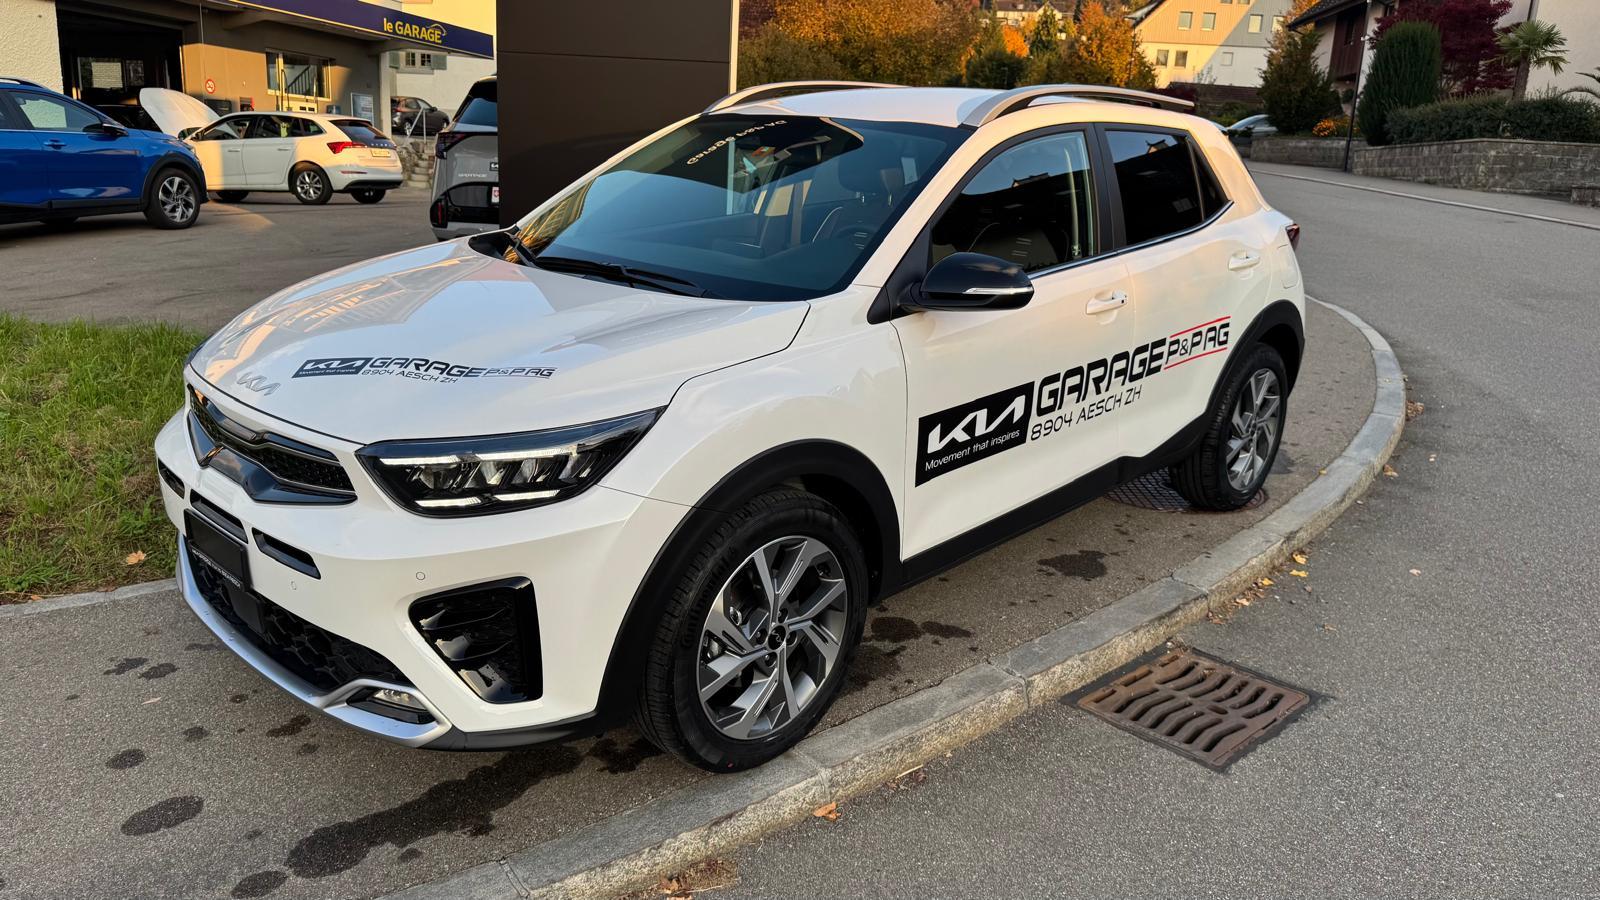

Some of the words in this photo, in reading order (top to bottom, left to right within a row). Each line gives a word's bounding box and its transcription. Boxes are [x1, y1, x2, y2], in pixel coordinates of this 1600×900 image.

[383, 17, 393, 32] le
[395, 21, 442, 43] GARAGE
[303, 360, 365, 370] KIA
[369, 357, 488, 377] GARAGE
[484, 367, 526, 376] P&P
[525, 368, 556, 377] AG
[395, 370, 439, 382] AESCH
[1036, 338, 1167, 417] GARAGE
[1165, 330, 1203, 364] P&P
[1203, 322, 1230, 351] AG
[236, 371, 281, 397] KIA
[927, 394, 1026, 454] KIA
[1030, 411, 1073, 441] 8904
[1076, 392, 1123, 425] AESCH
[1124, 384, 1143, 405] ZH
[925, 446, 971, 471] Movement
[972, 439, 989, 453] that
[990, 429, 1020, 446] inspires
